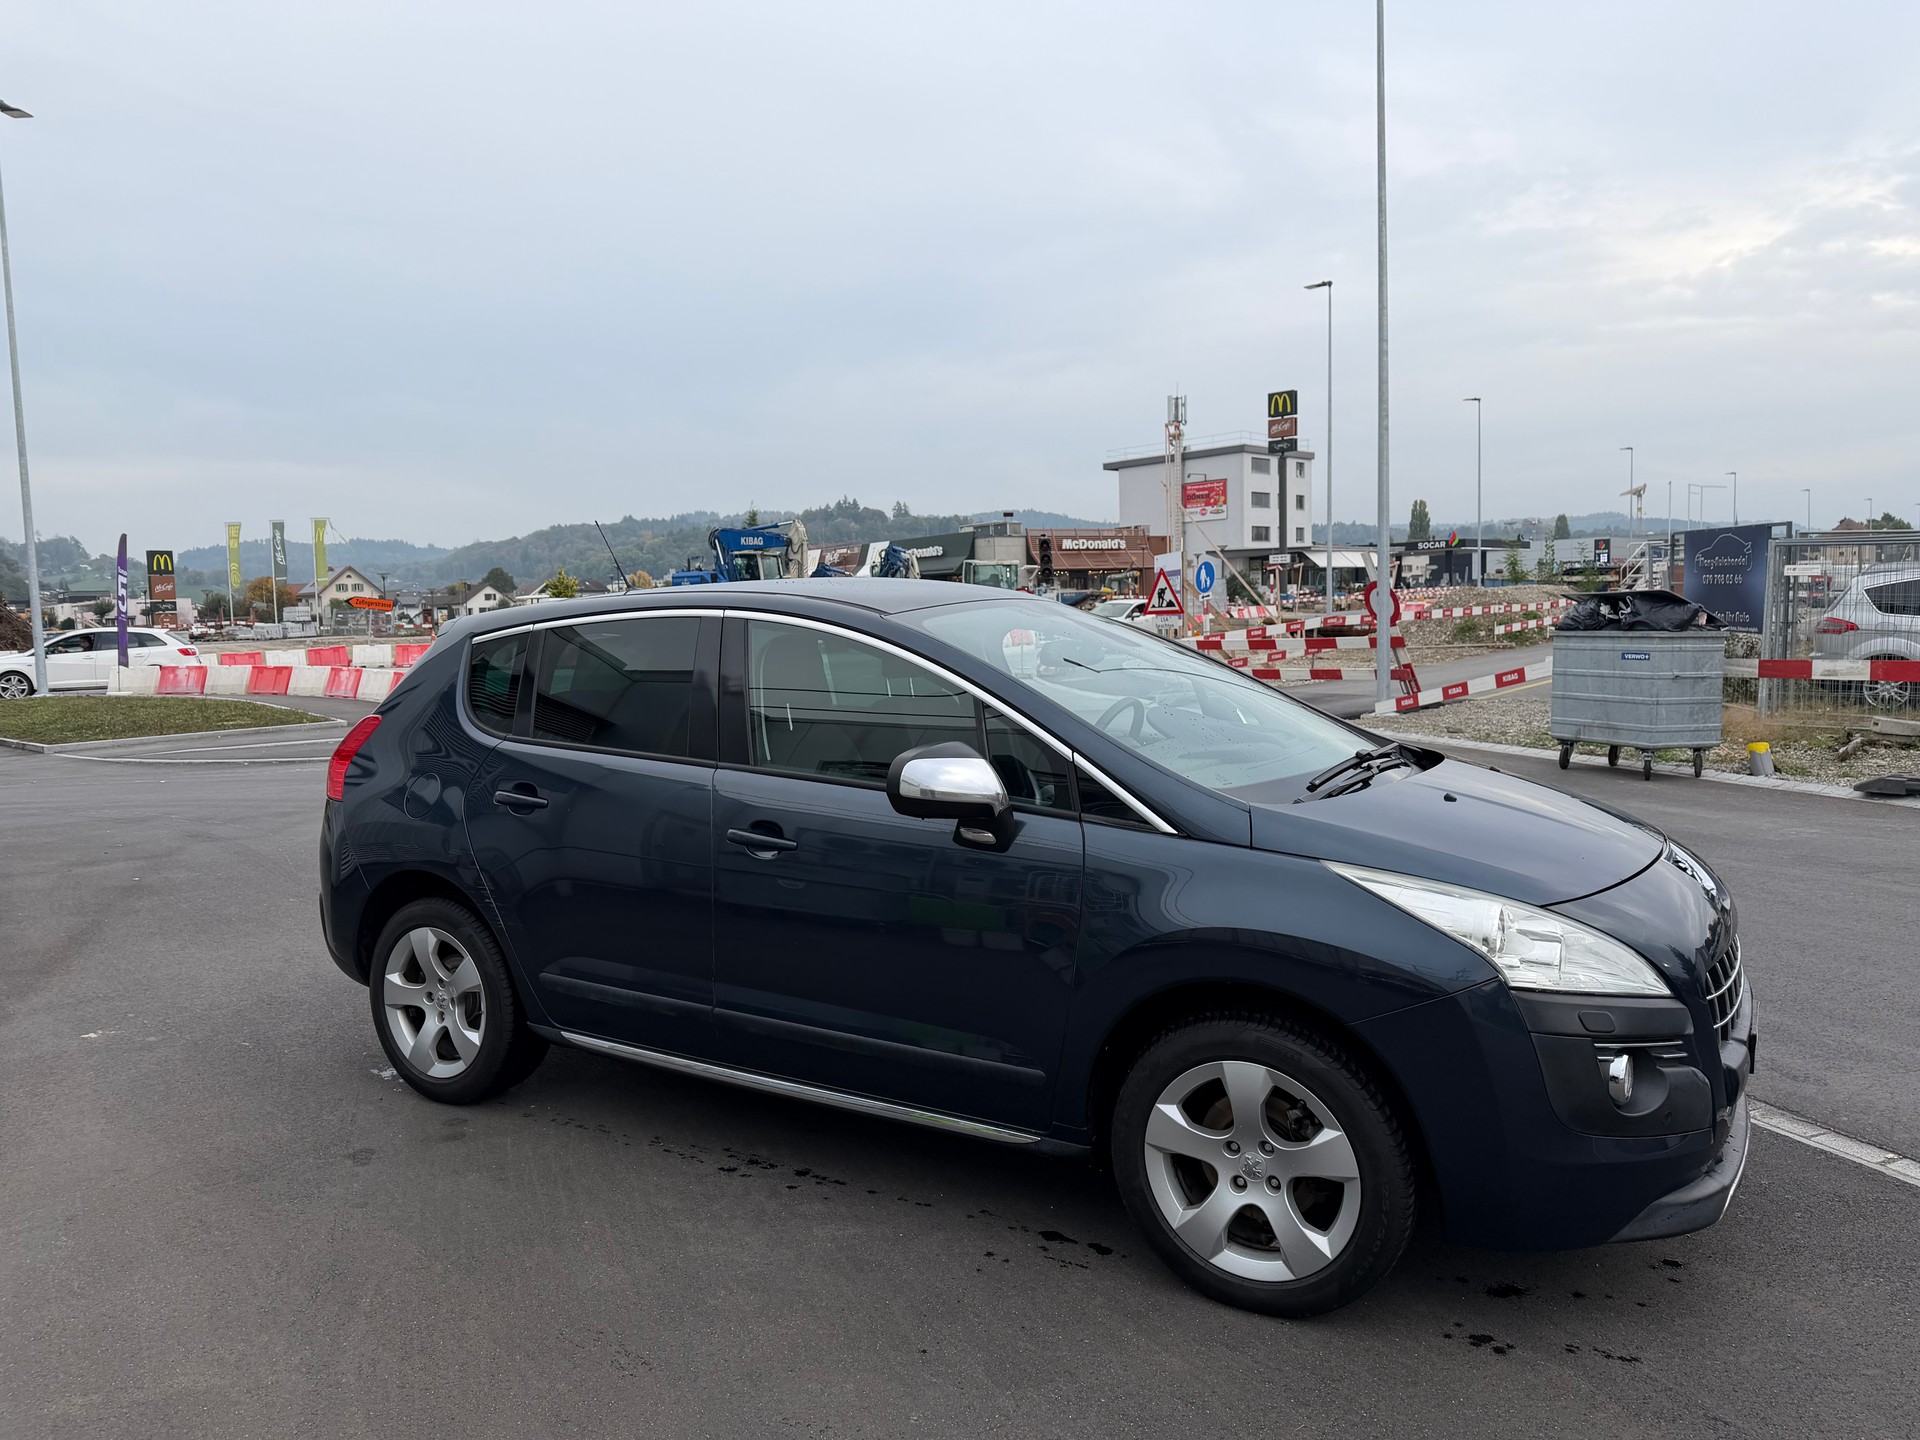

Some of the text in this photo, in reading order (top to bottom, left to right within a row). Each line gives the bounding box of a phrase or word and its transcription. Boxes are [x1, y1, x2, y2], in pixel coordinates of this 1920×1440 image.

[740, 536, 764, 546] KIBAG
[1061, 538, 1127, 550] McDonald's
[1417, 541, 1446, 550] SOCAR
[355, 598, 392, 608] Zofingerstrasse
[1502, 672, 1519, 682] KIBAG
[1447, 686, 1463, 695] KIBAG
[1400, 697, 1414, 706] KIBAG
